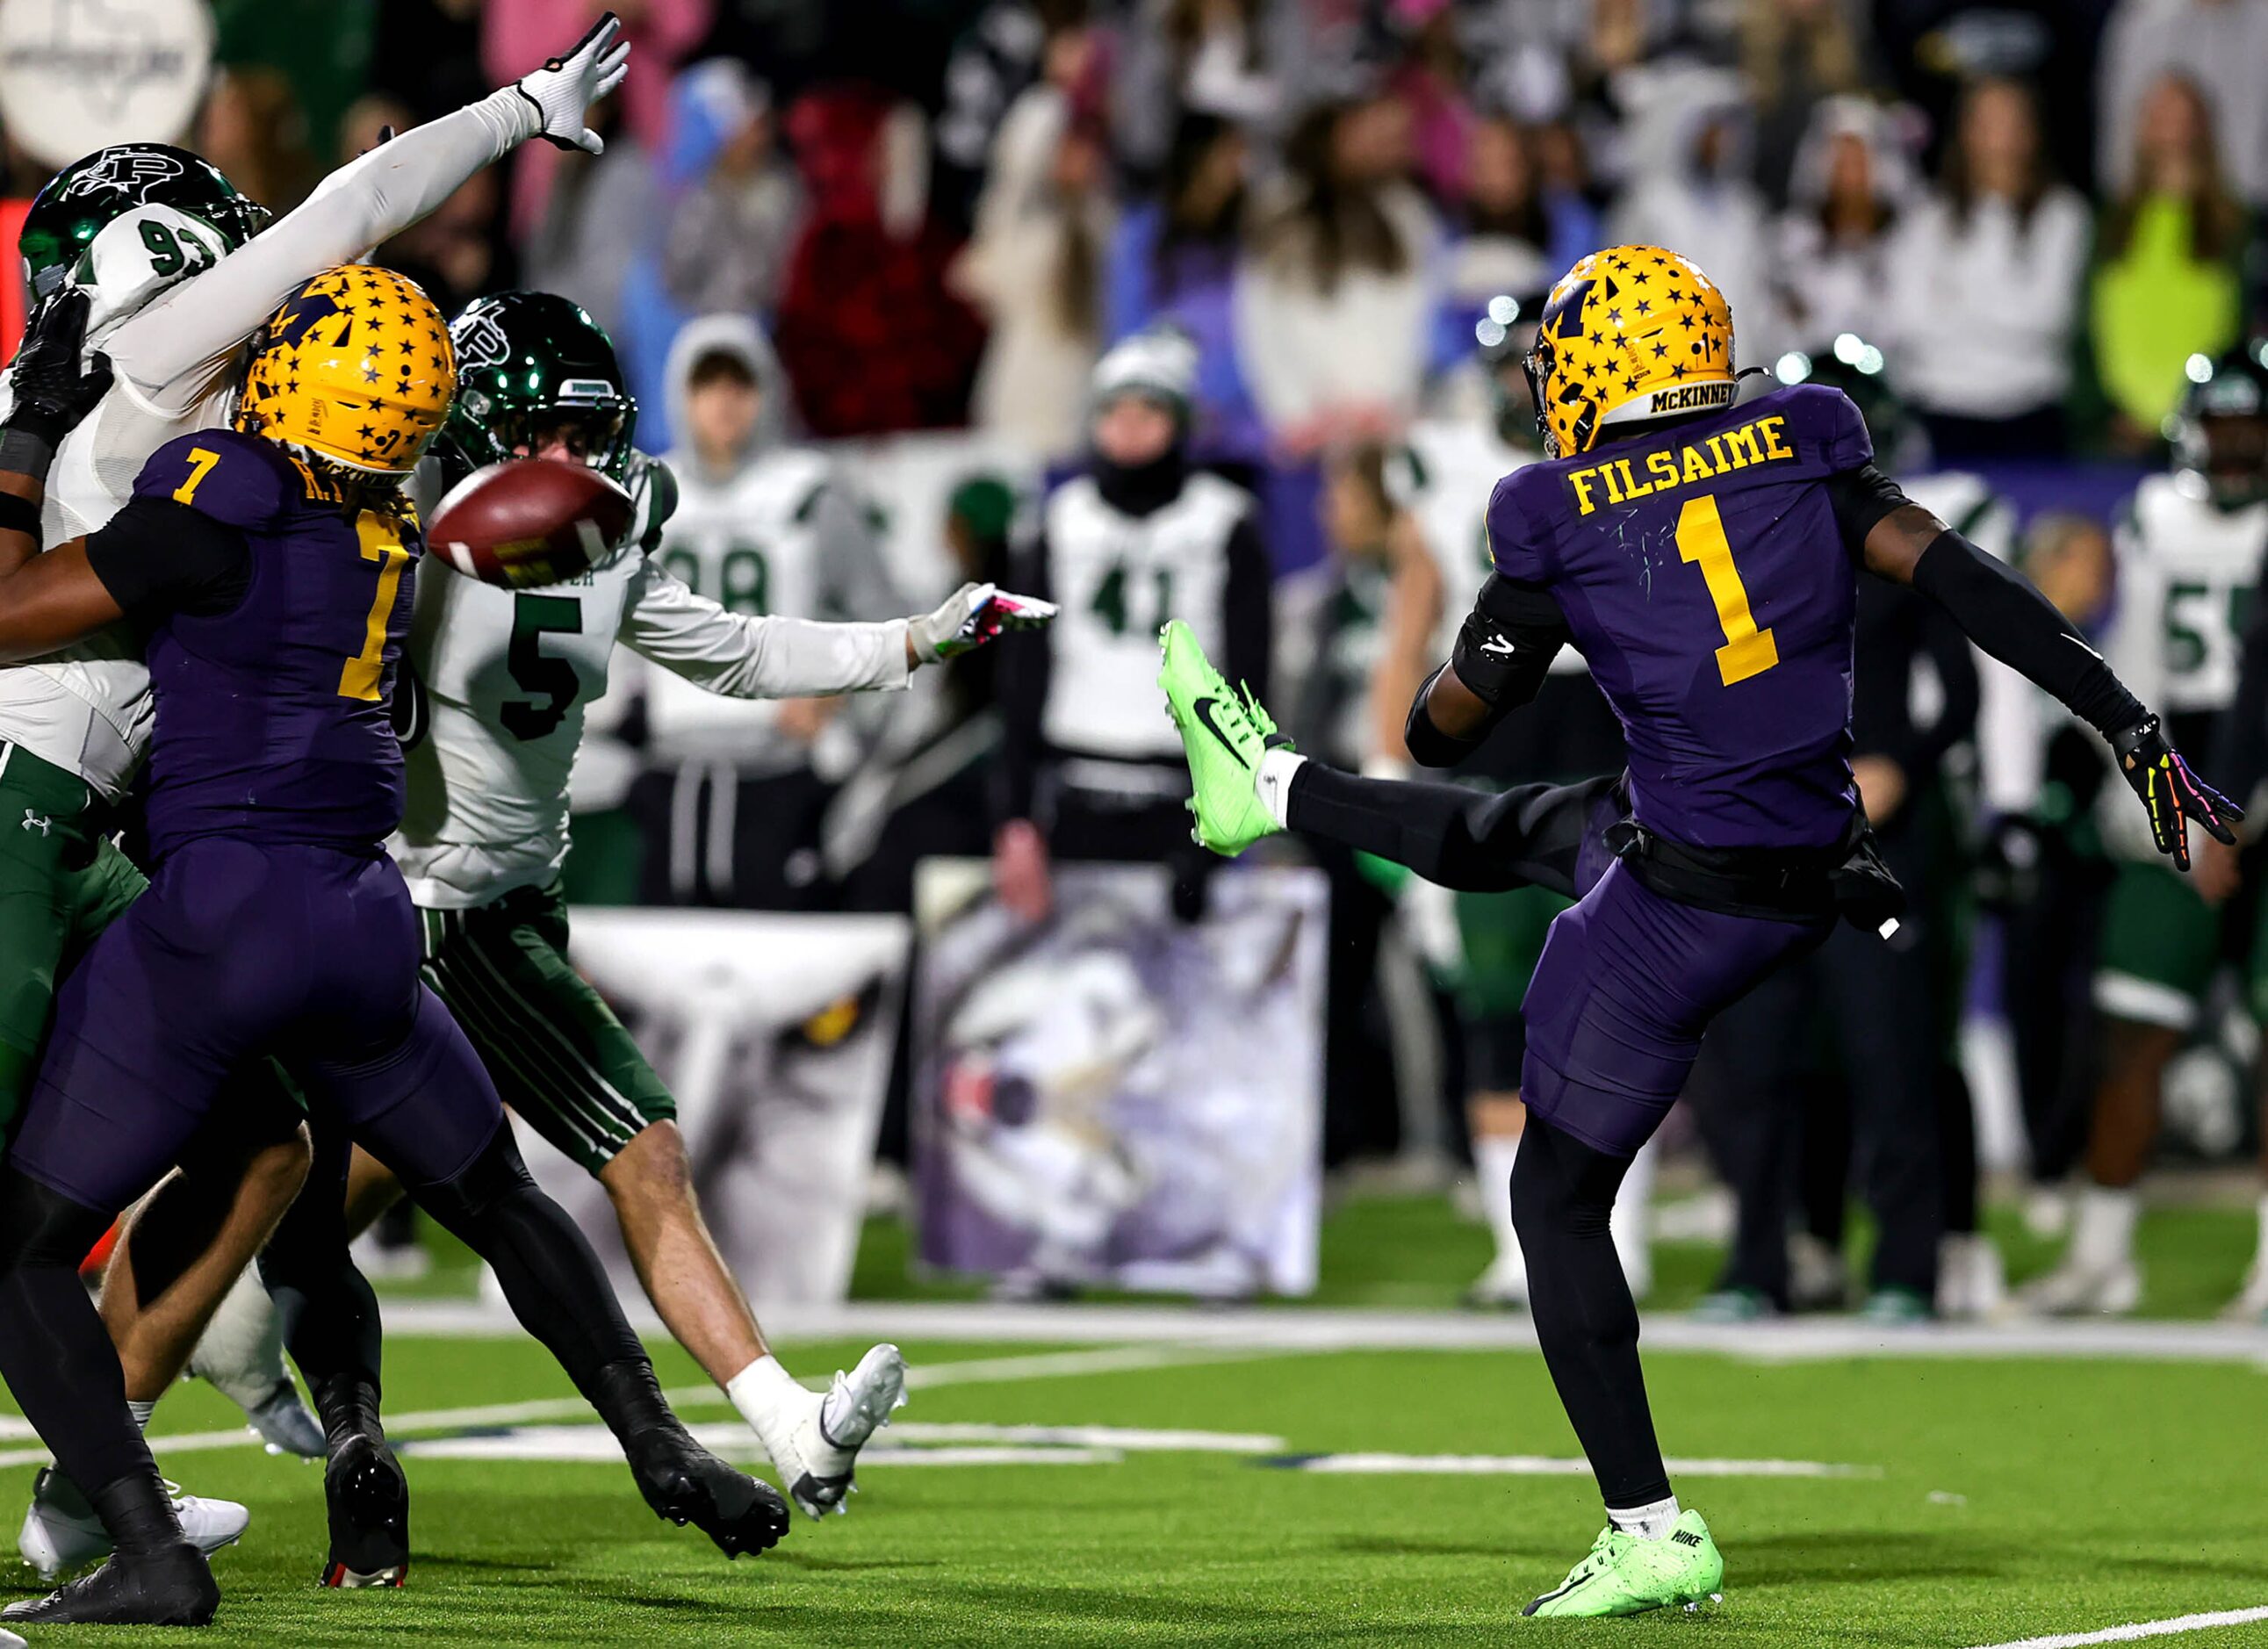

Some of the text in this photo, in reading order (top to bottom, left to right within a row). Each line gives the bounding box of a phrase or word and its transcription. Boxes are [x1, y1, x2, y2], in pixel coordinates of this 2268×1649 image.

[137, 220, 217, 277] 93
[172, 447, 221, 507] 7
[379, 428, 401, 456] 7
[1567, 415, 1794, 516] FILSAIME
[337, 508, 410, 702] 7
[1674, 493, 1780, 688] 1
[500, 592, 584, 742] 5
[1670, 1529, 1704, 1548] NIKE
